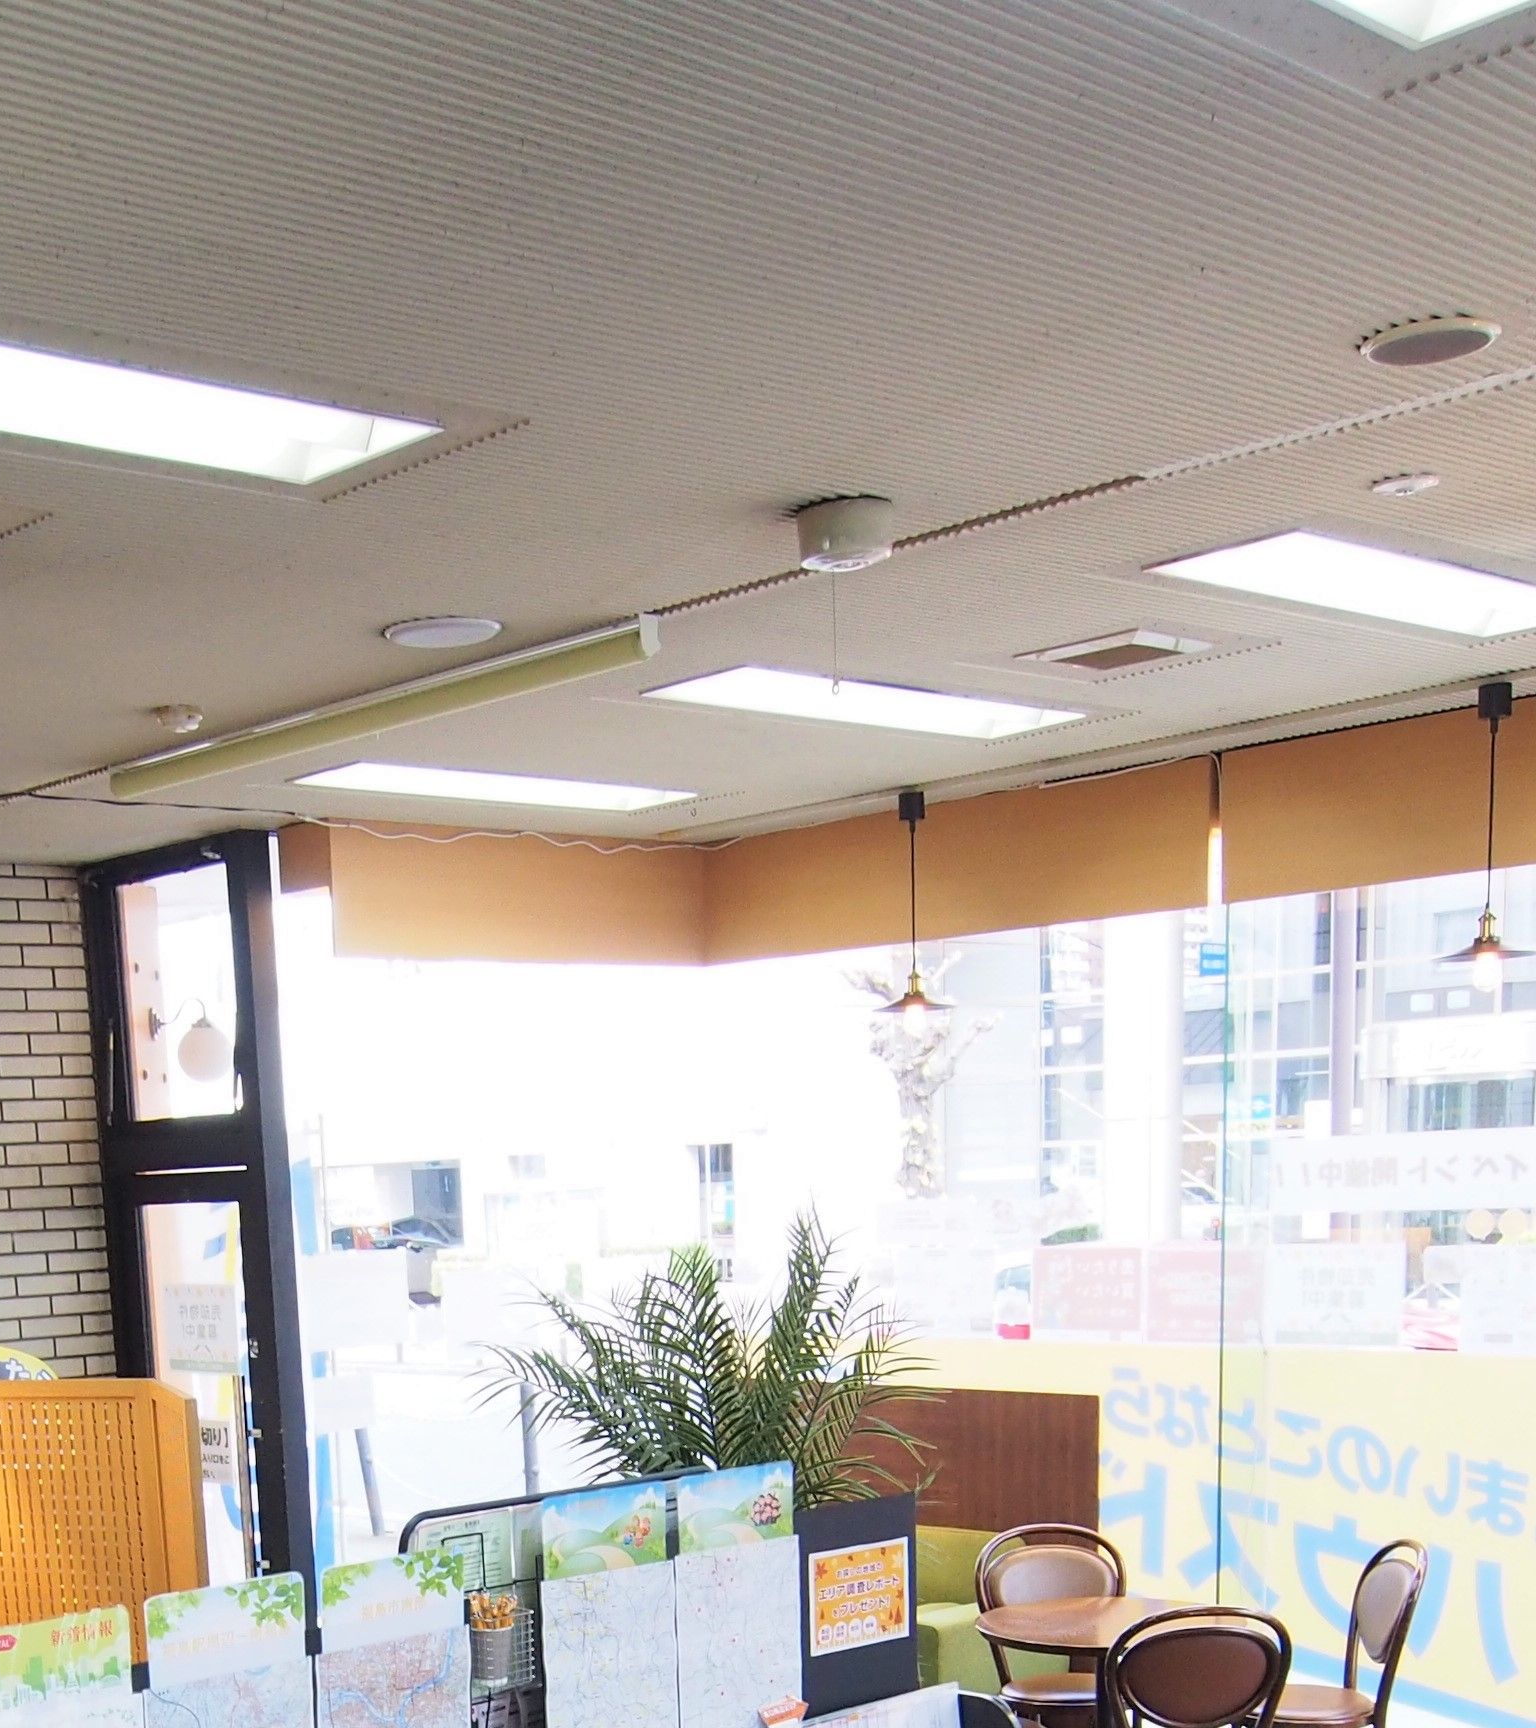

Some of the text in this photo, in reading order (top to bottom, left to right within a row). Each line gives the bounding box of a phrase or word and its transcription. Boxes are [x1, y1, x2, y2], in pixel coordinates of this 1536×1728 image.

[818, 1575, 900, 1601] エリア調査レポート
